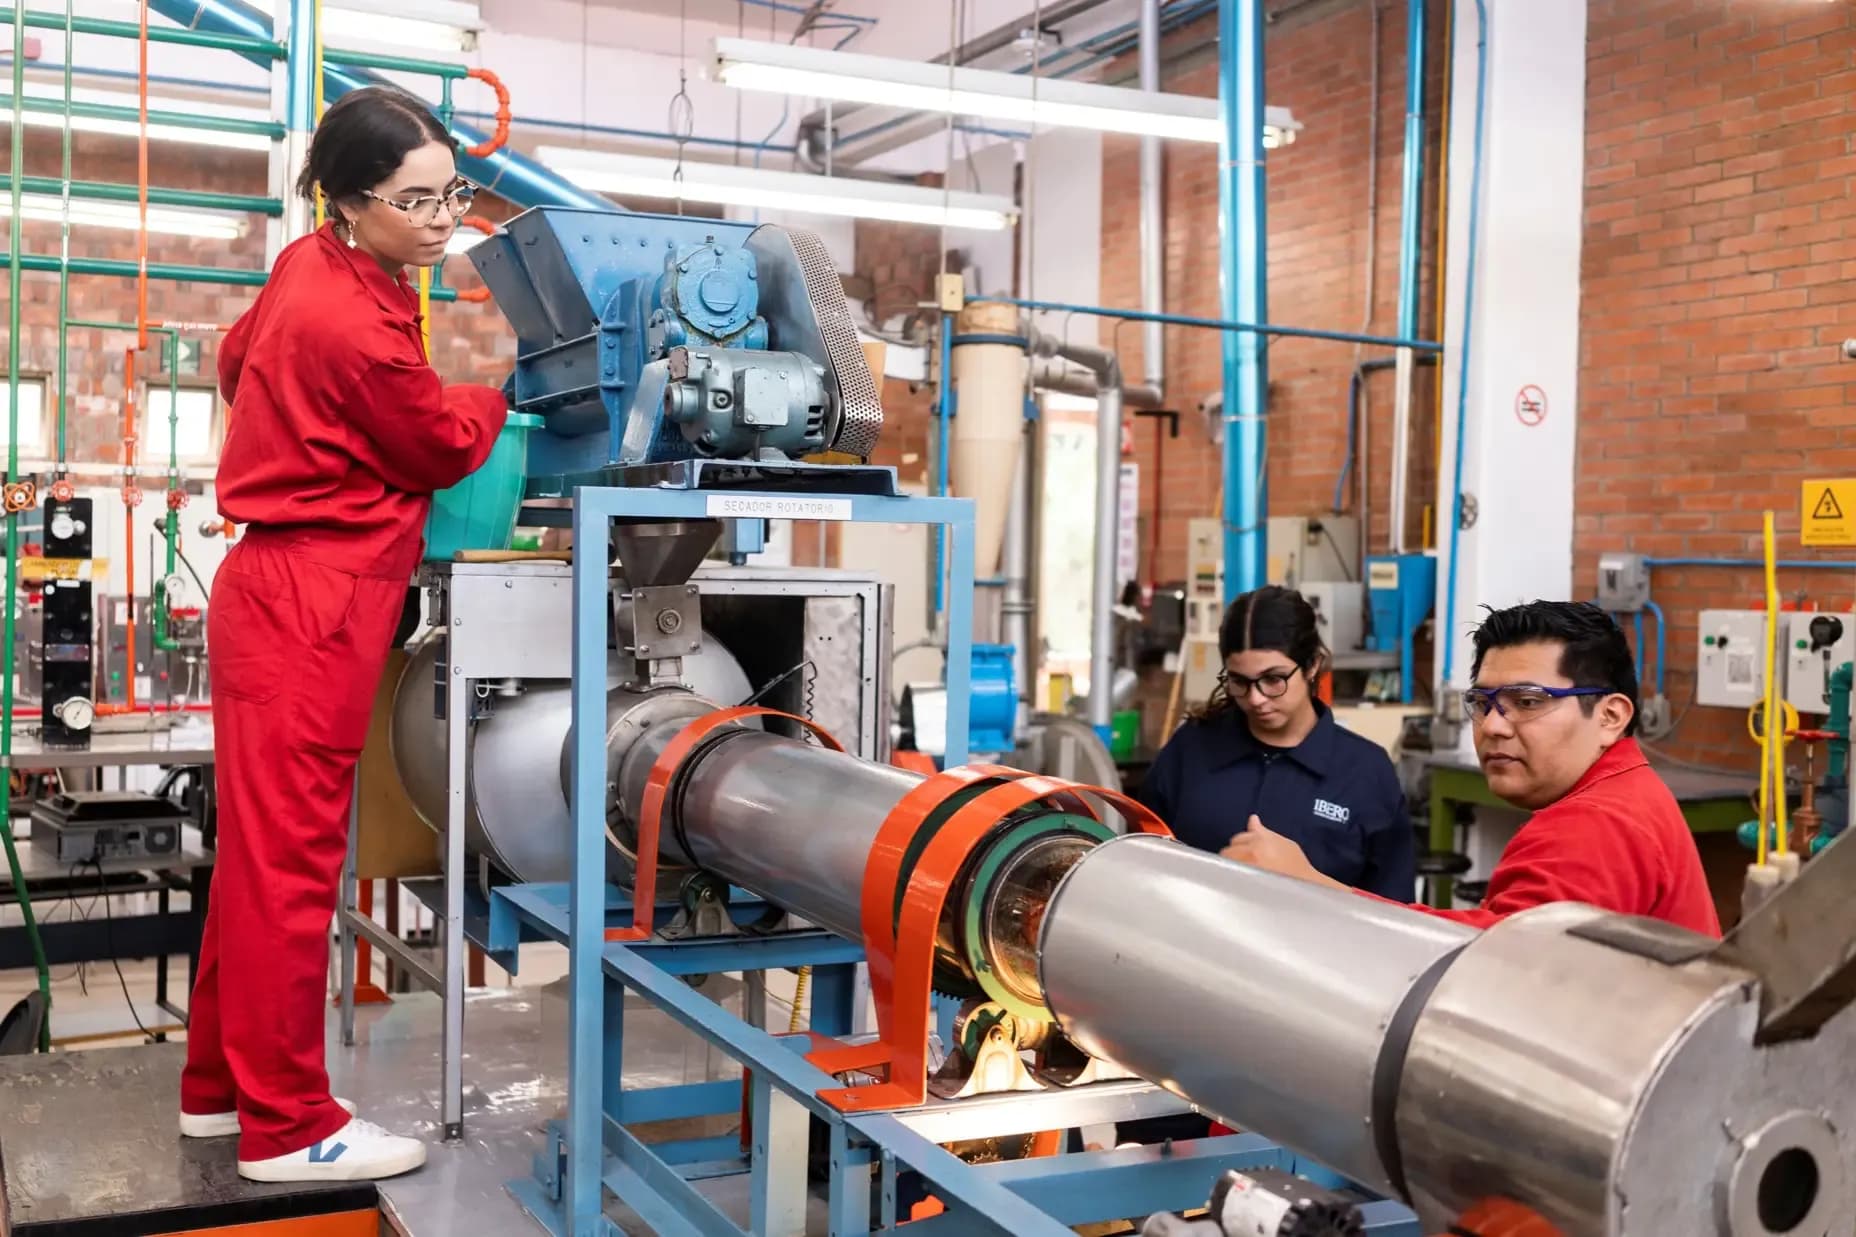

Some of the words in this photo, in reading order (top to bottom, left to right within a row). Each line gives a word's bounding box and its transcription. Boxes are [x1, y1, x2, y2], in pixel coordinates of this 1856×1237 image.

[724, 500, 772, 513] SECADOR
[777, 502, 834, 514] ROTATORIO
[1313, 798, 1350, 821] IBERO
